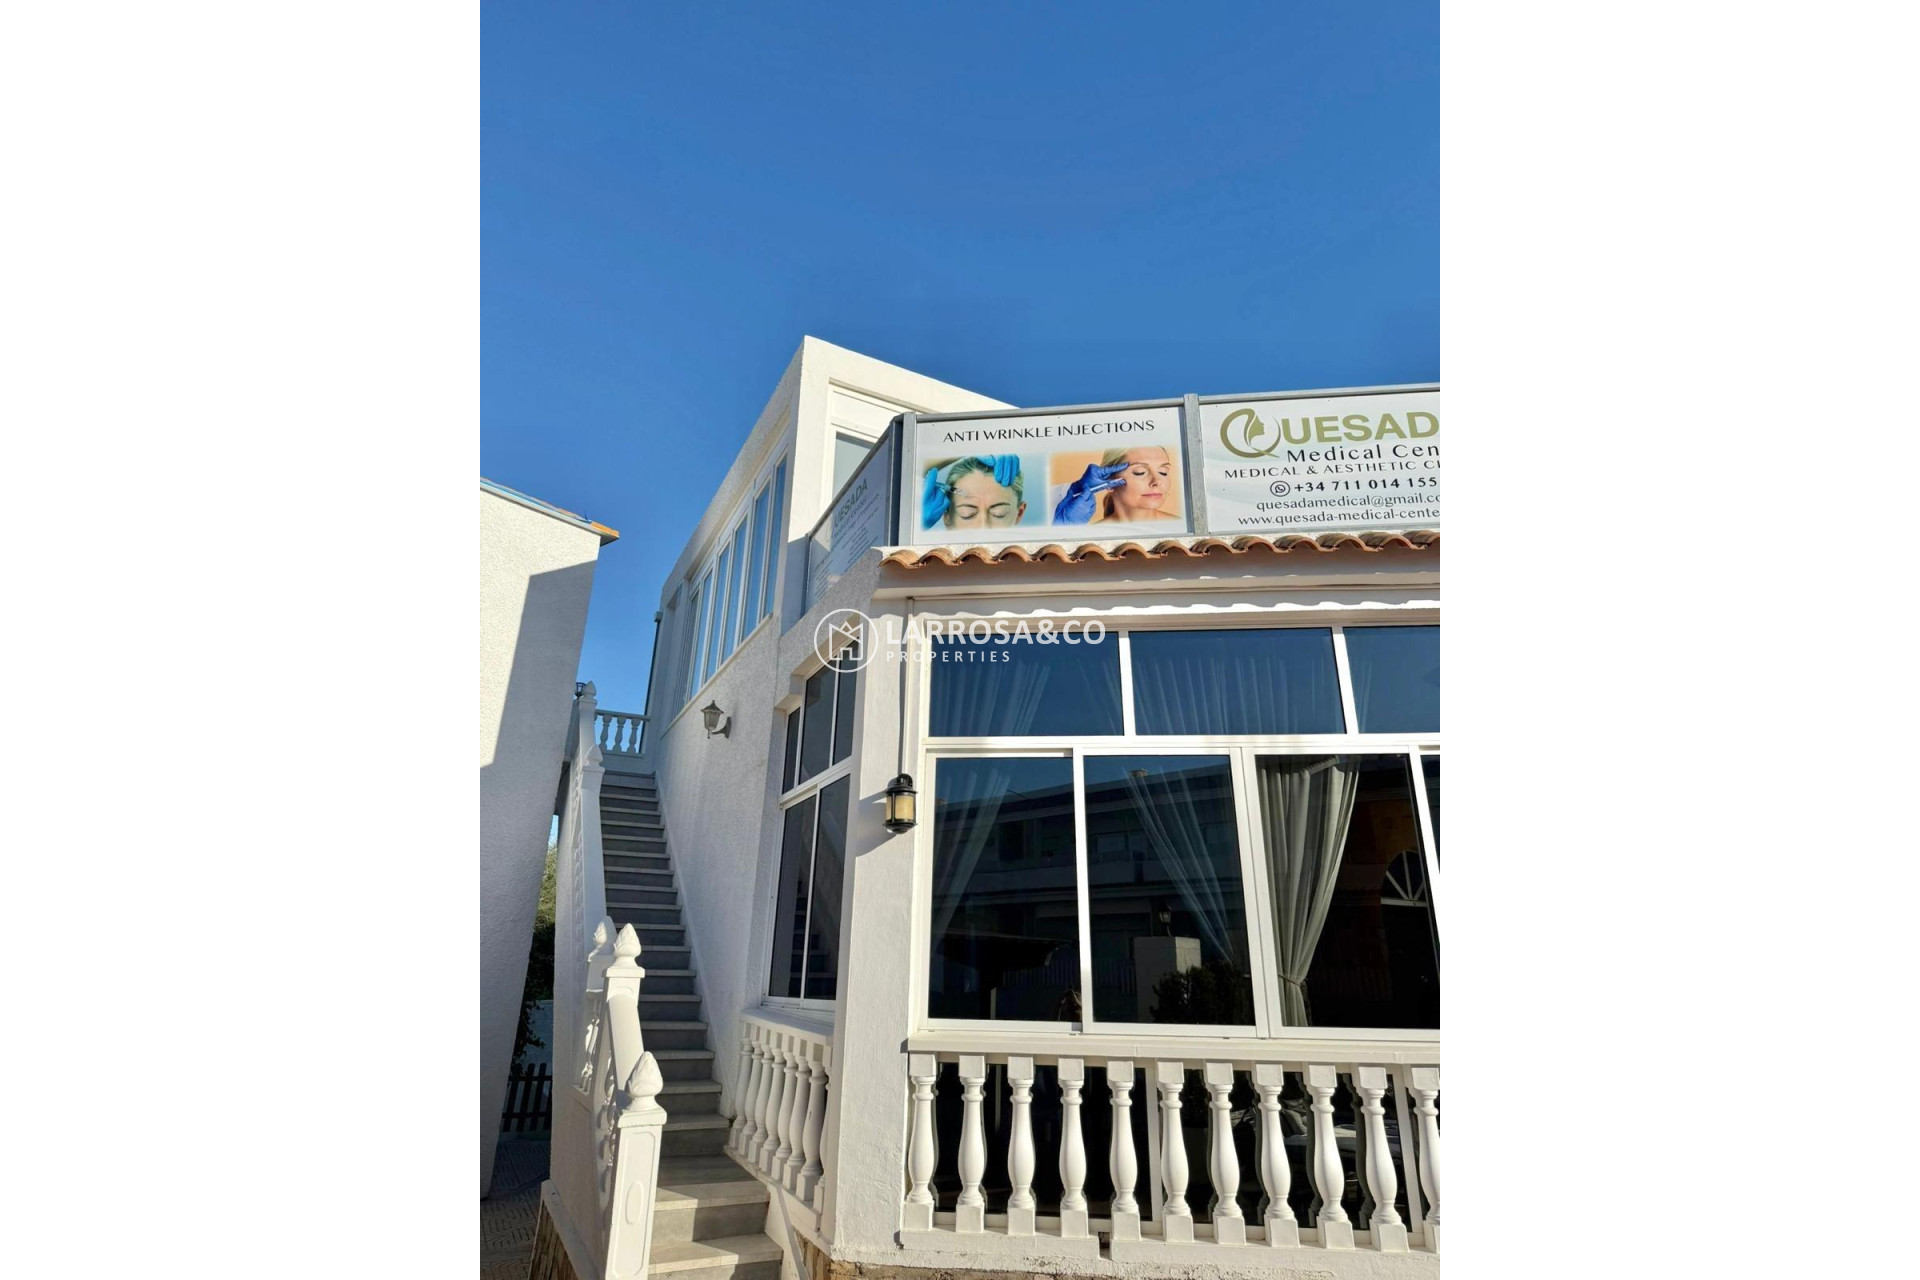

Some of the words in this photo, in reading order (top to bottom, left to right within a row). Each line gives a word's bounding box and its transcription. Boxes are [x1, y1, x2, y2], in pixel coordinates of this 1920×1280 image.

[943, 430, 979, 443] ANTI
[983, 426, 1053, 442] WRINKLE
[1057, 420, 1155, 436] INJECTIONS
[1287, 444, 1381, 462] Medical
[1392, 444, 1440, 458] Cen
[1225, 466, 1300, 478] MEDICAL
[1306, 465, 1318, 475] &
[1323, 461, 1416, 475] AESTHETIC
[1294, 481, 1325, 492] +34
[1332, 480, 1360, 491] 711
[1368, 478, 1400, 490] 014
[1407, 477, 1437, 488] 155
